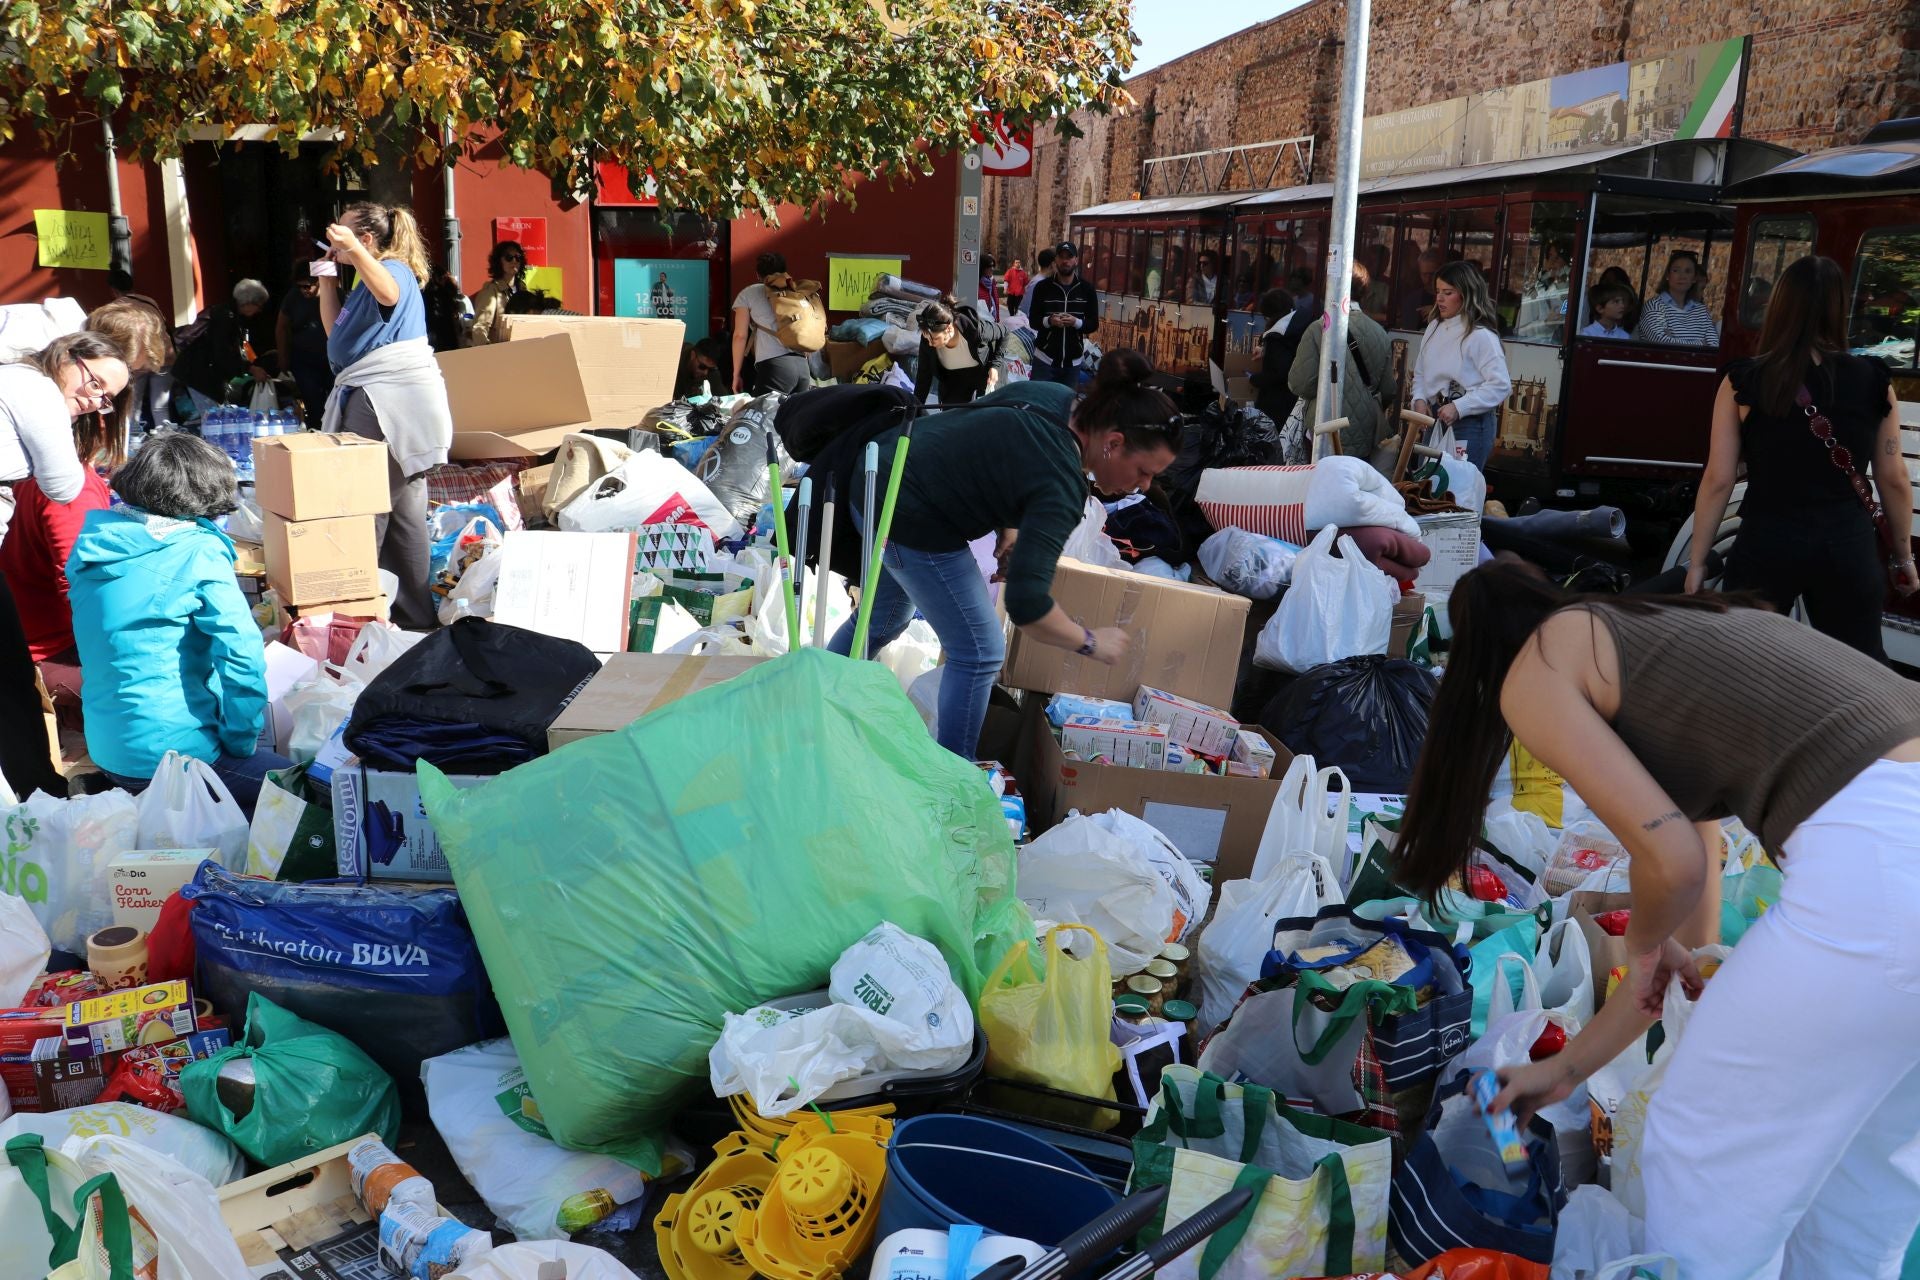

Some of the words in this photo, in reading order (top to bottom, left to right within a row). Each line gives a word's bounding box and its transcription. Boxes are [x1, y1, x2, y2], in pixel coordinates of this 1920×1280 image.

[1400, 106, 1443, 125] RESTAURANTE
[635, 292, 650, 304] 12
[652, 295, 688, 305] meses
[637, 303, 653, 315] sin
[338, 779, 356, 876] Restform
[115, 884, 152, 896] Corn
[116, 896, 165, 909] Flakes
[351, 943, 430, 966] BBVA
[853, 977, 892, 1016] FROIZ
